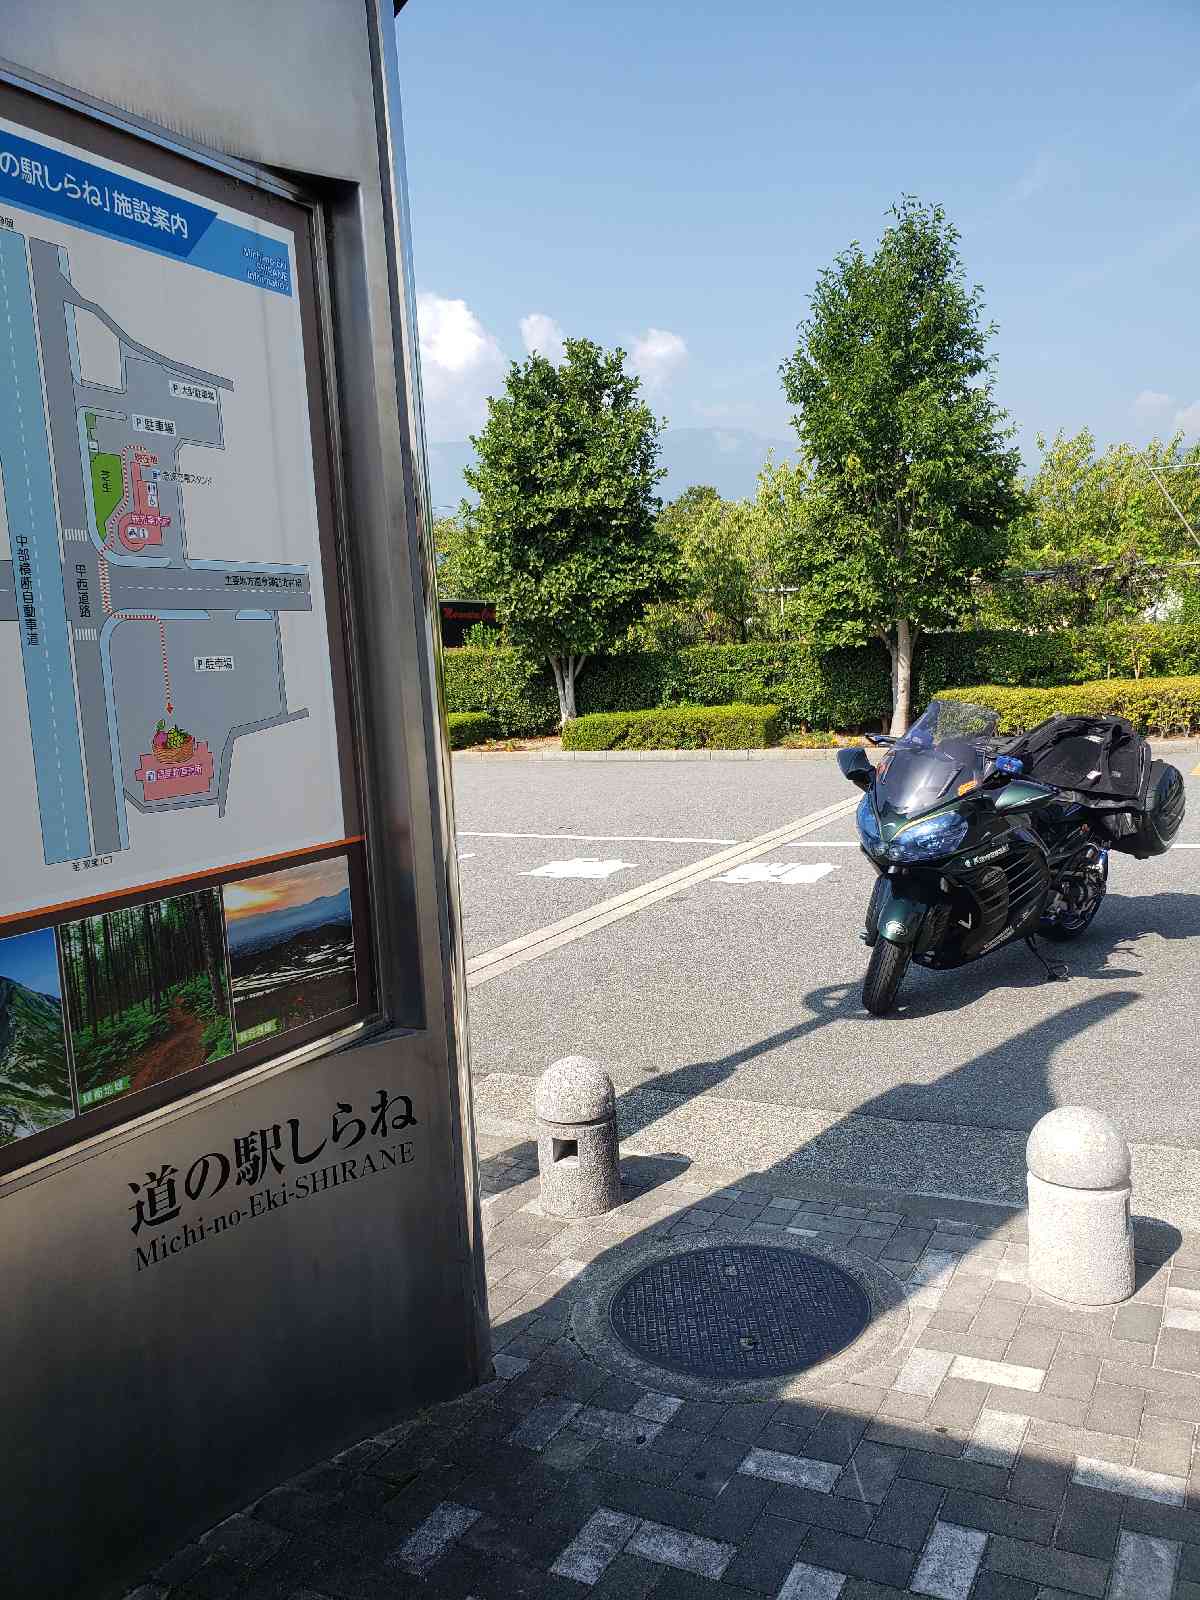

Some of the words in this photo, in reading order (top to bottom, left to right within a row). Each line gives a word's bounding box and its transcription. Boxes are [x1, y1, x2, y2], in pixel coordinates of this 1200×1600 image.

[0, 152, 189, 239] の駅しらね」施設案内
[144, 418, 175, 435] 駐車場
[15, 534, 40, 646] 中部横断自動車道
[75, 563, 91, 618] 甲西道路
[127, 1090, 418, 1235] 道の駅しらね
[135, 1141, 416, 1272] Michi-no-Eki-SHIRANE
